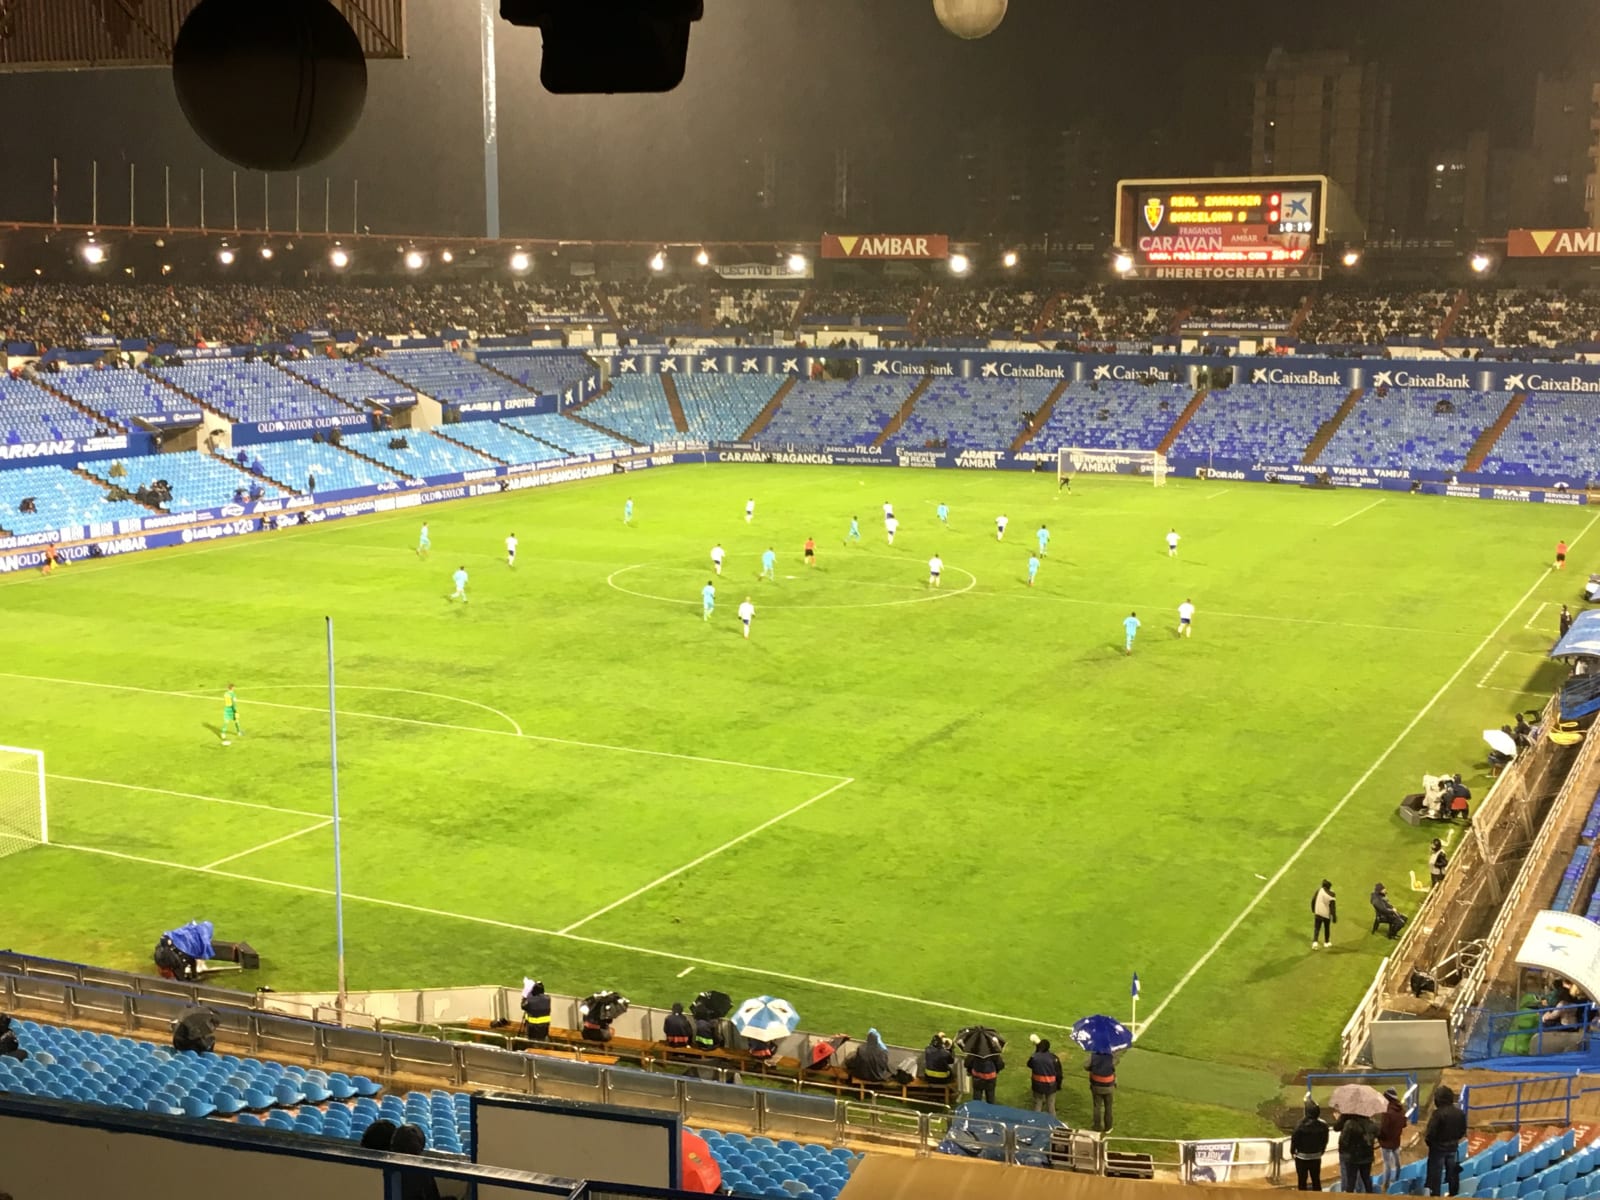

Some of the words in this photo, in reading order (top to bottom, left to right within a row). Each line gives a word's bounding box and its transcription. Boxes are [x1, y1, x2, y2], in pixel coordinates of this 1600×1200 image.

[860, 238, 930, 256] AMBAR
[1140, 236, 1222, 251] CARAVAN
[1555, 232, 1600, 252] AM
[1156, 267, 1285, 278] #HERETOCREATE
[891, 360, 954, 376] Caixaank
[1000, 363, 1065, 379] CaixaBank
[1270, 368, 1341, 386] CaixaBank
[1395, 371, 1470, 389] CaixaBank
[1527, 374, 1600, 392] CaixaBan
[257, 422, 276, 433] OLD
[285, 419, 313, 431] TAYLOR
[315, 416, 333, 428] OLD
[341, 415, 368, 425] TAYLOR
[961, 458, 997, 468] AMBAR
[1081, 462, 1118, 472] AMBAR
[1299, 465, 1328, 474] AMBAR
[1339, 467, 1368, 476] AMBAR
[107, 536, 147, 556] AMBAR
